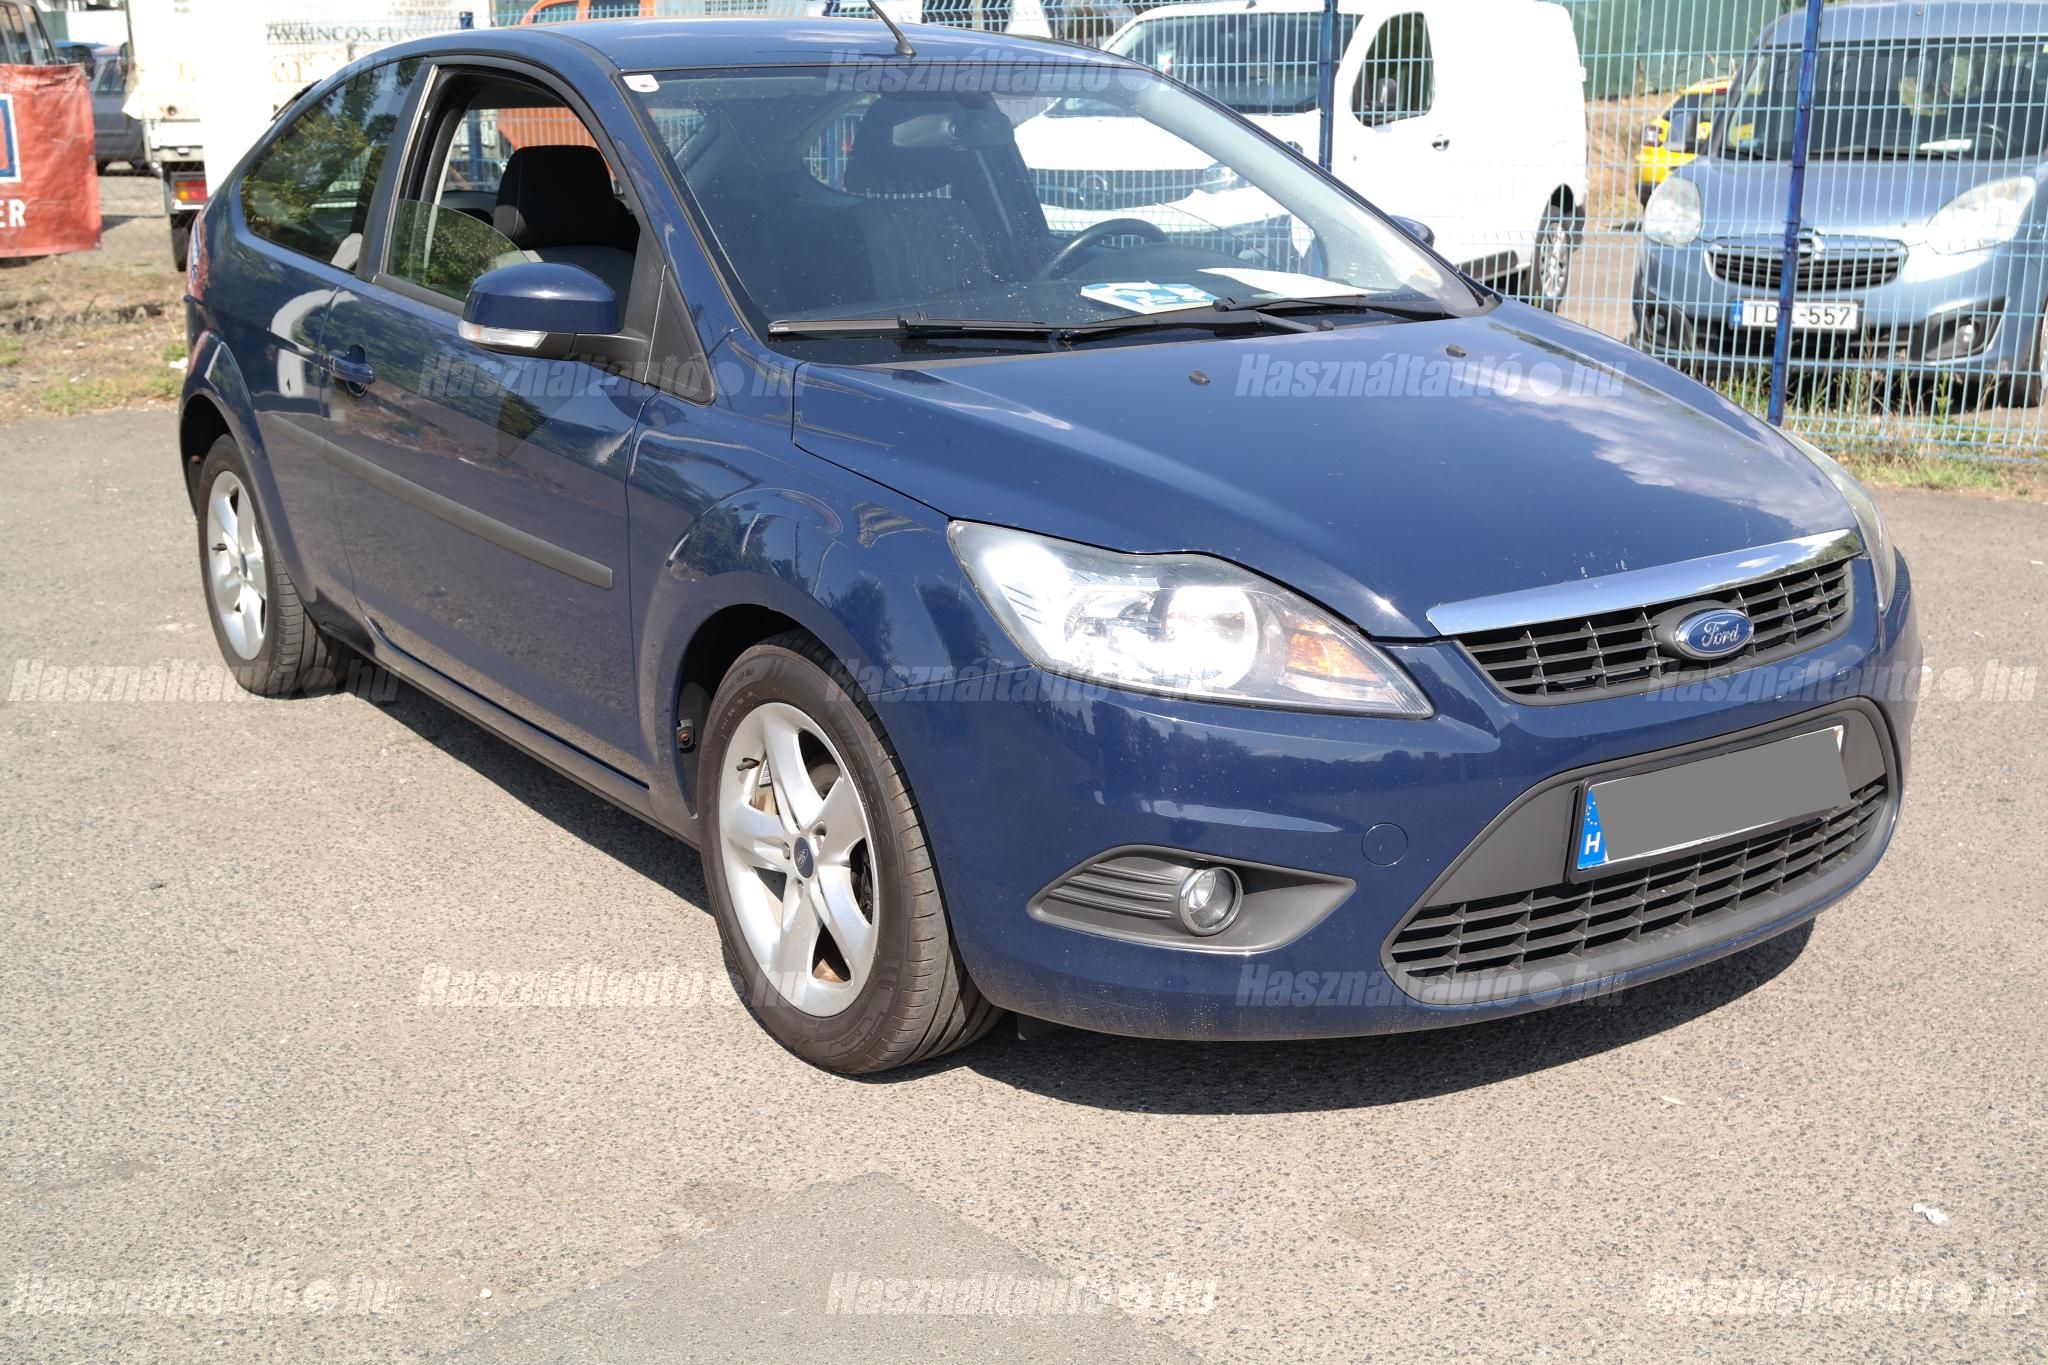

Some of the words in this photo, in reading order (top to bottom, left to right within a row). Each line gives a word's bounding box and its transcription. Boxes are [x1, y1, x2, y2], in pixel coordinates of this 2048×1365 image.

[1749, 304, 1851, 326] TD-557
[1701, 621, 1740, 647] Ford
[1584, 831, 1601, 855] H
